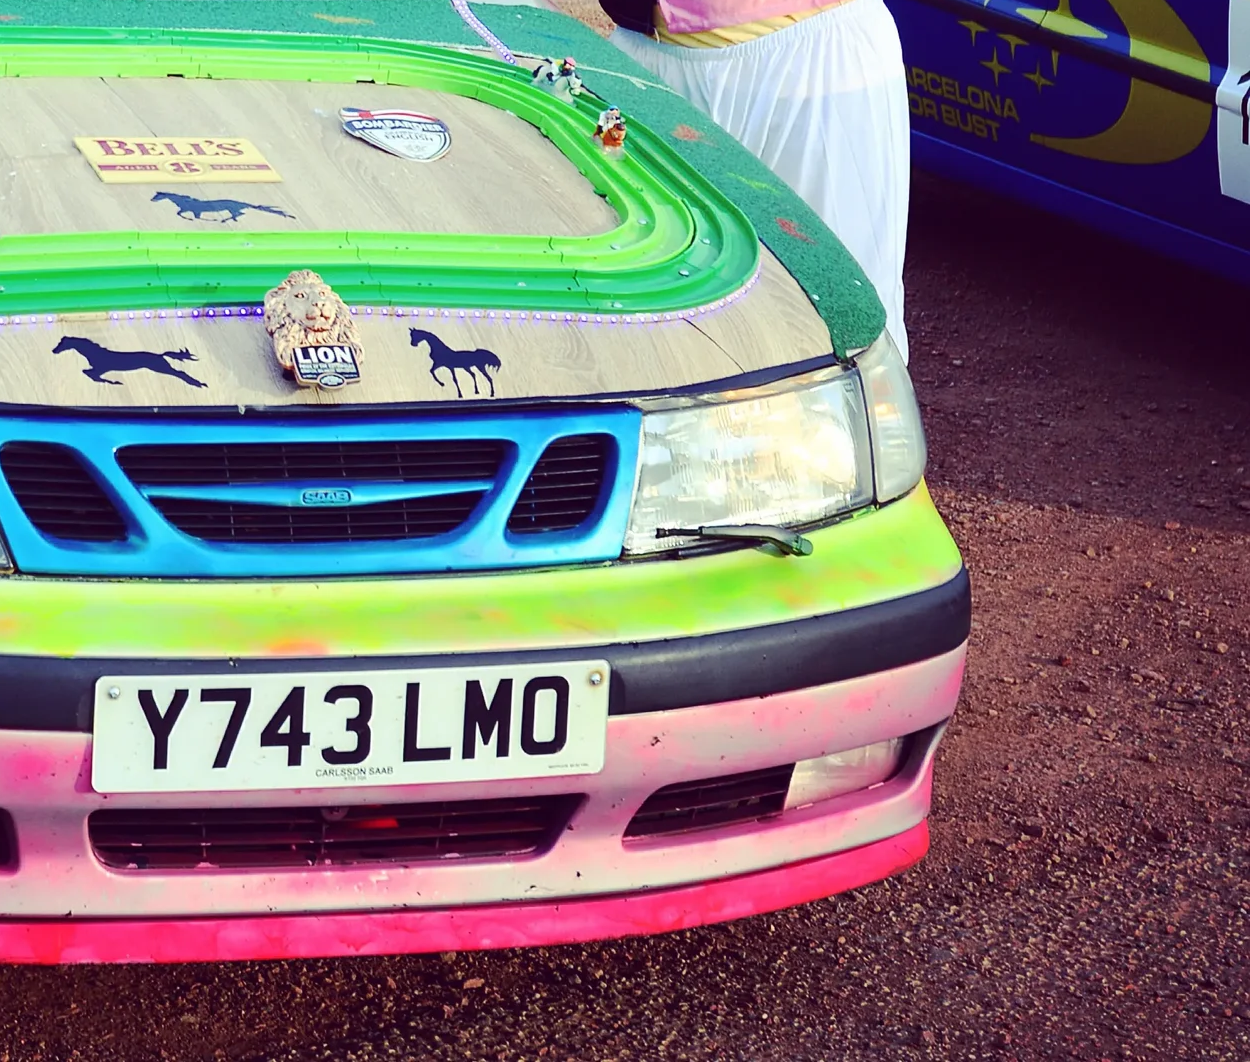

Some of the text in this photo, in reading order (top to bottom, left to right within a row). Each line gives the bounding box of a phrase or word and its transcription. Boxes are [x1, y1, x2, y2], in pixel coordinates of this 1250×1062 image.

[907, 66, 1020, 123] RCELONA
[351, 120, 445, 132] BOMBARDIER
[909, 92, 1001, 142] OR BUST
[294, 346, 354, 364] LION
[304, 491, 349, 504] SAAB
[137, 675, 570, 770] Y743 LMO
[315, 766, 394, 777] CARLSSON SAAB
